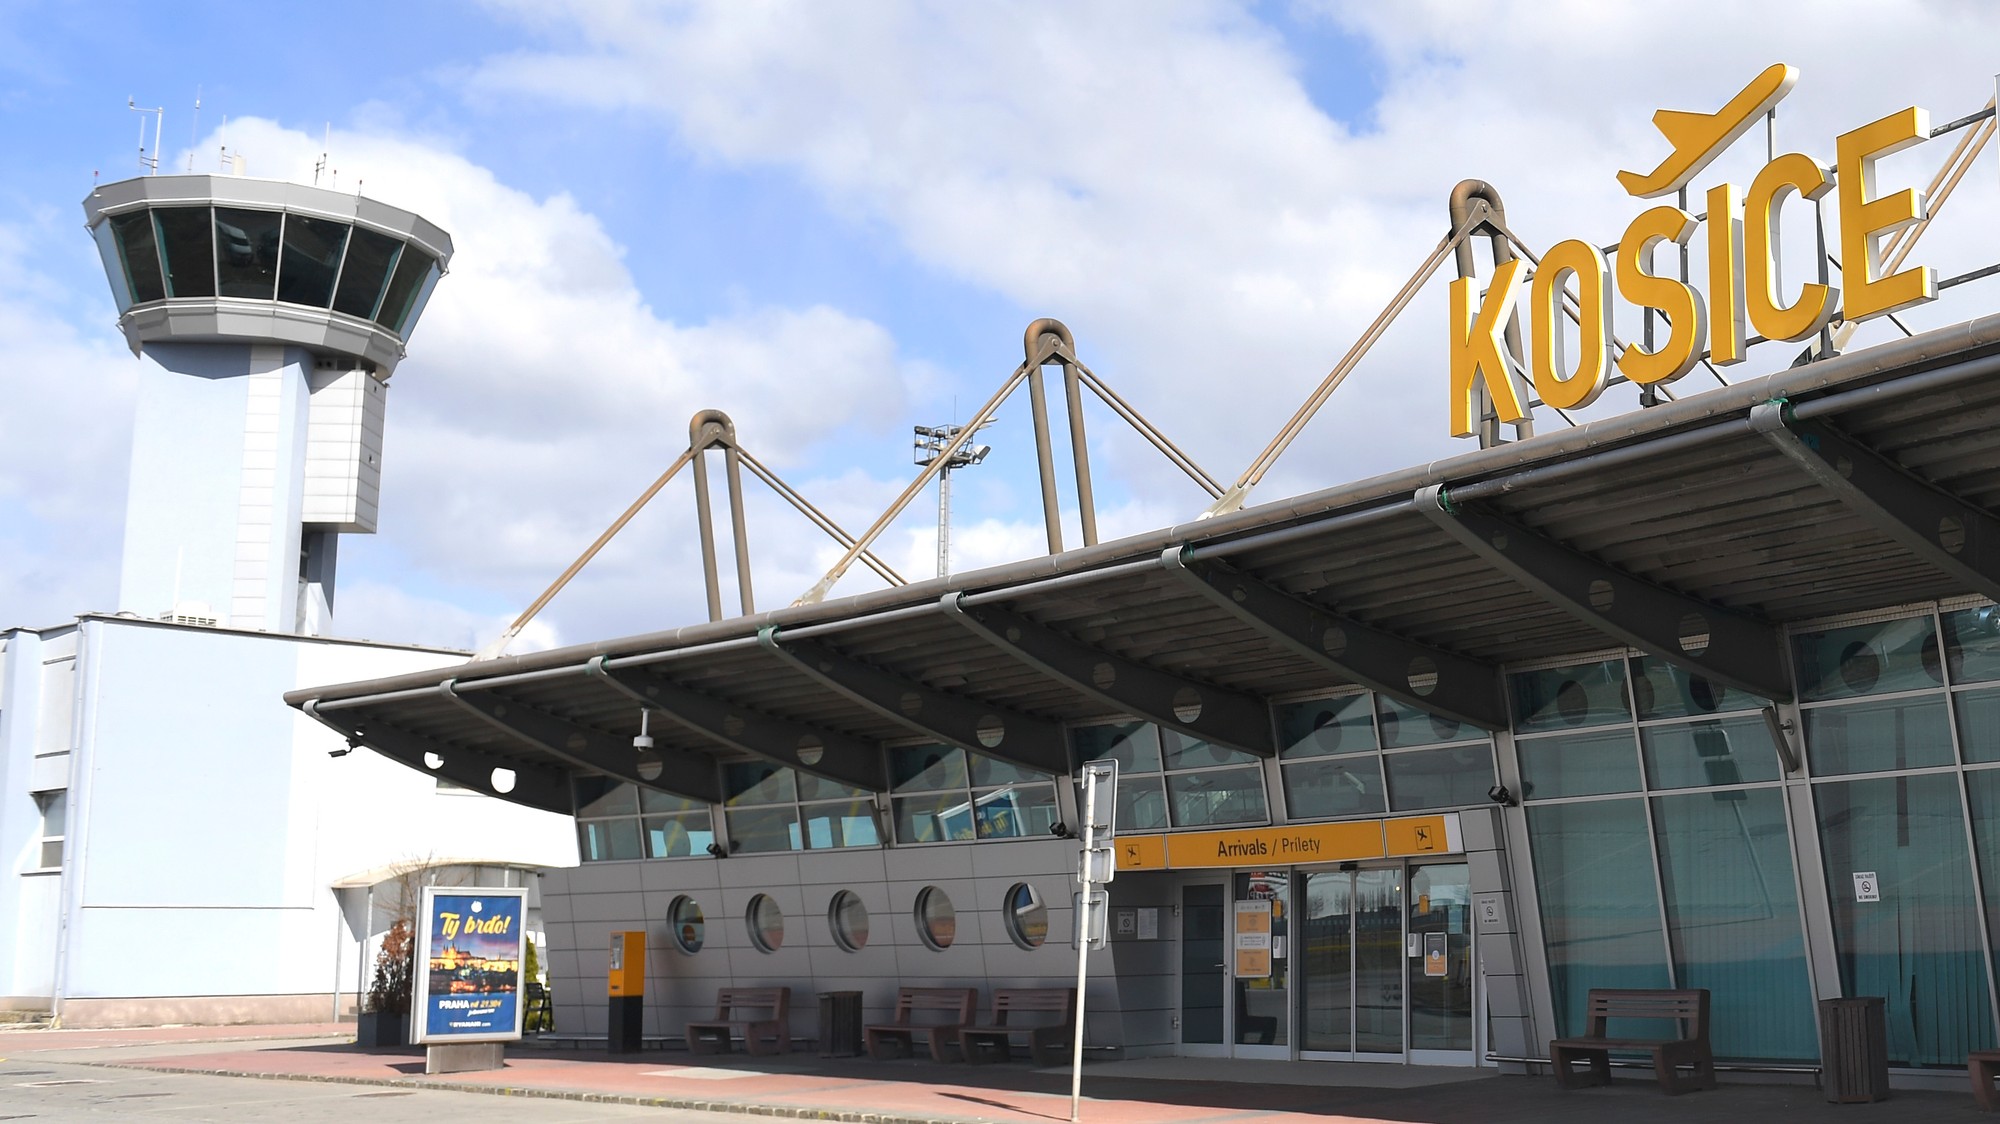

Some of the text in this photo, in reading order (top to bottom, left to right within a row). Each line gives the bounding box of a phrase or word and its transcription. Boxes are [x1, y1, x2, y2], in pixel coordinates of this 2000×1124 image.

[1217, 836, 1321, 858] Arrivals / Prílety
[440, 912, 461, 940] Ty
[439, 1000, 469, 1009] PRAHA
